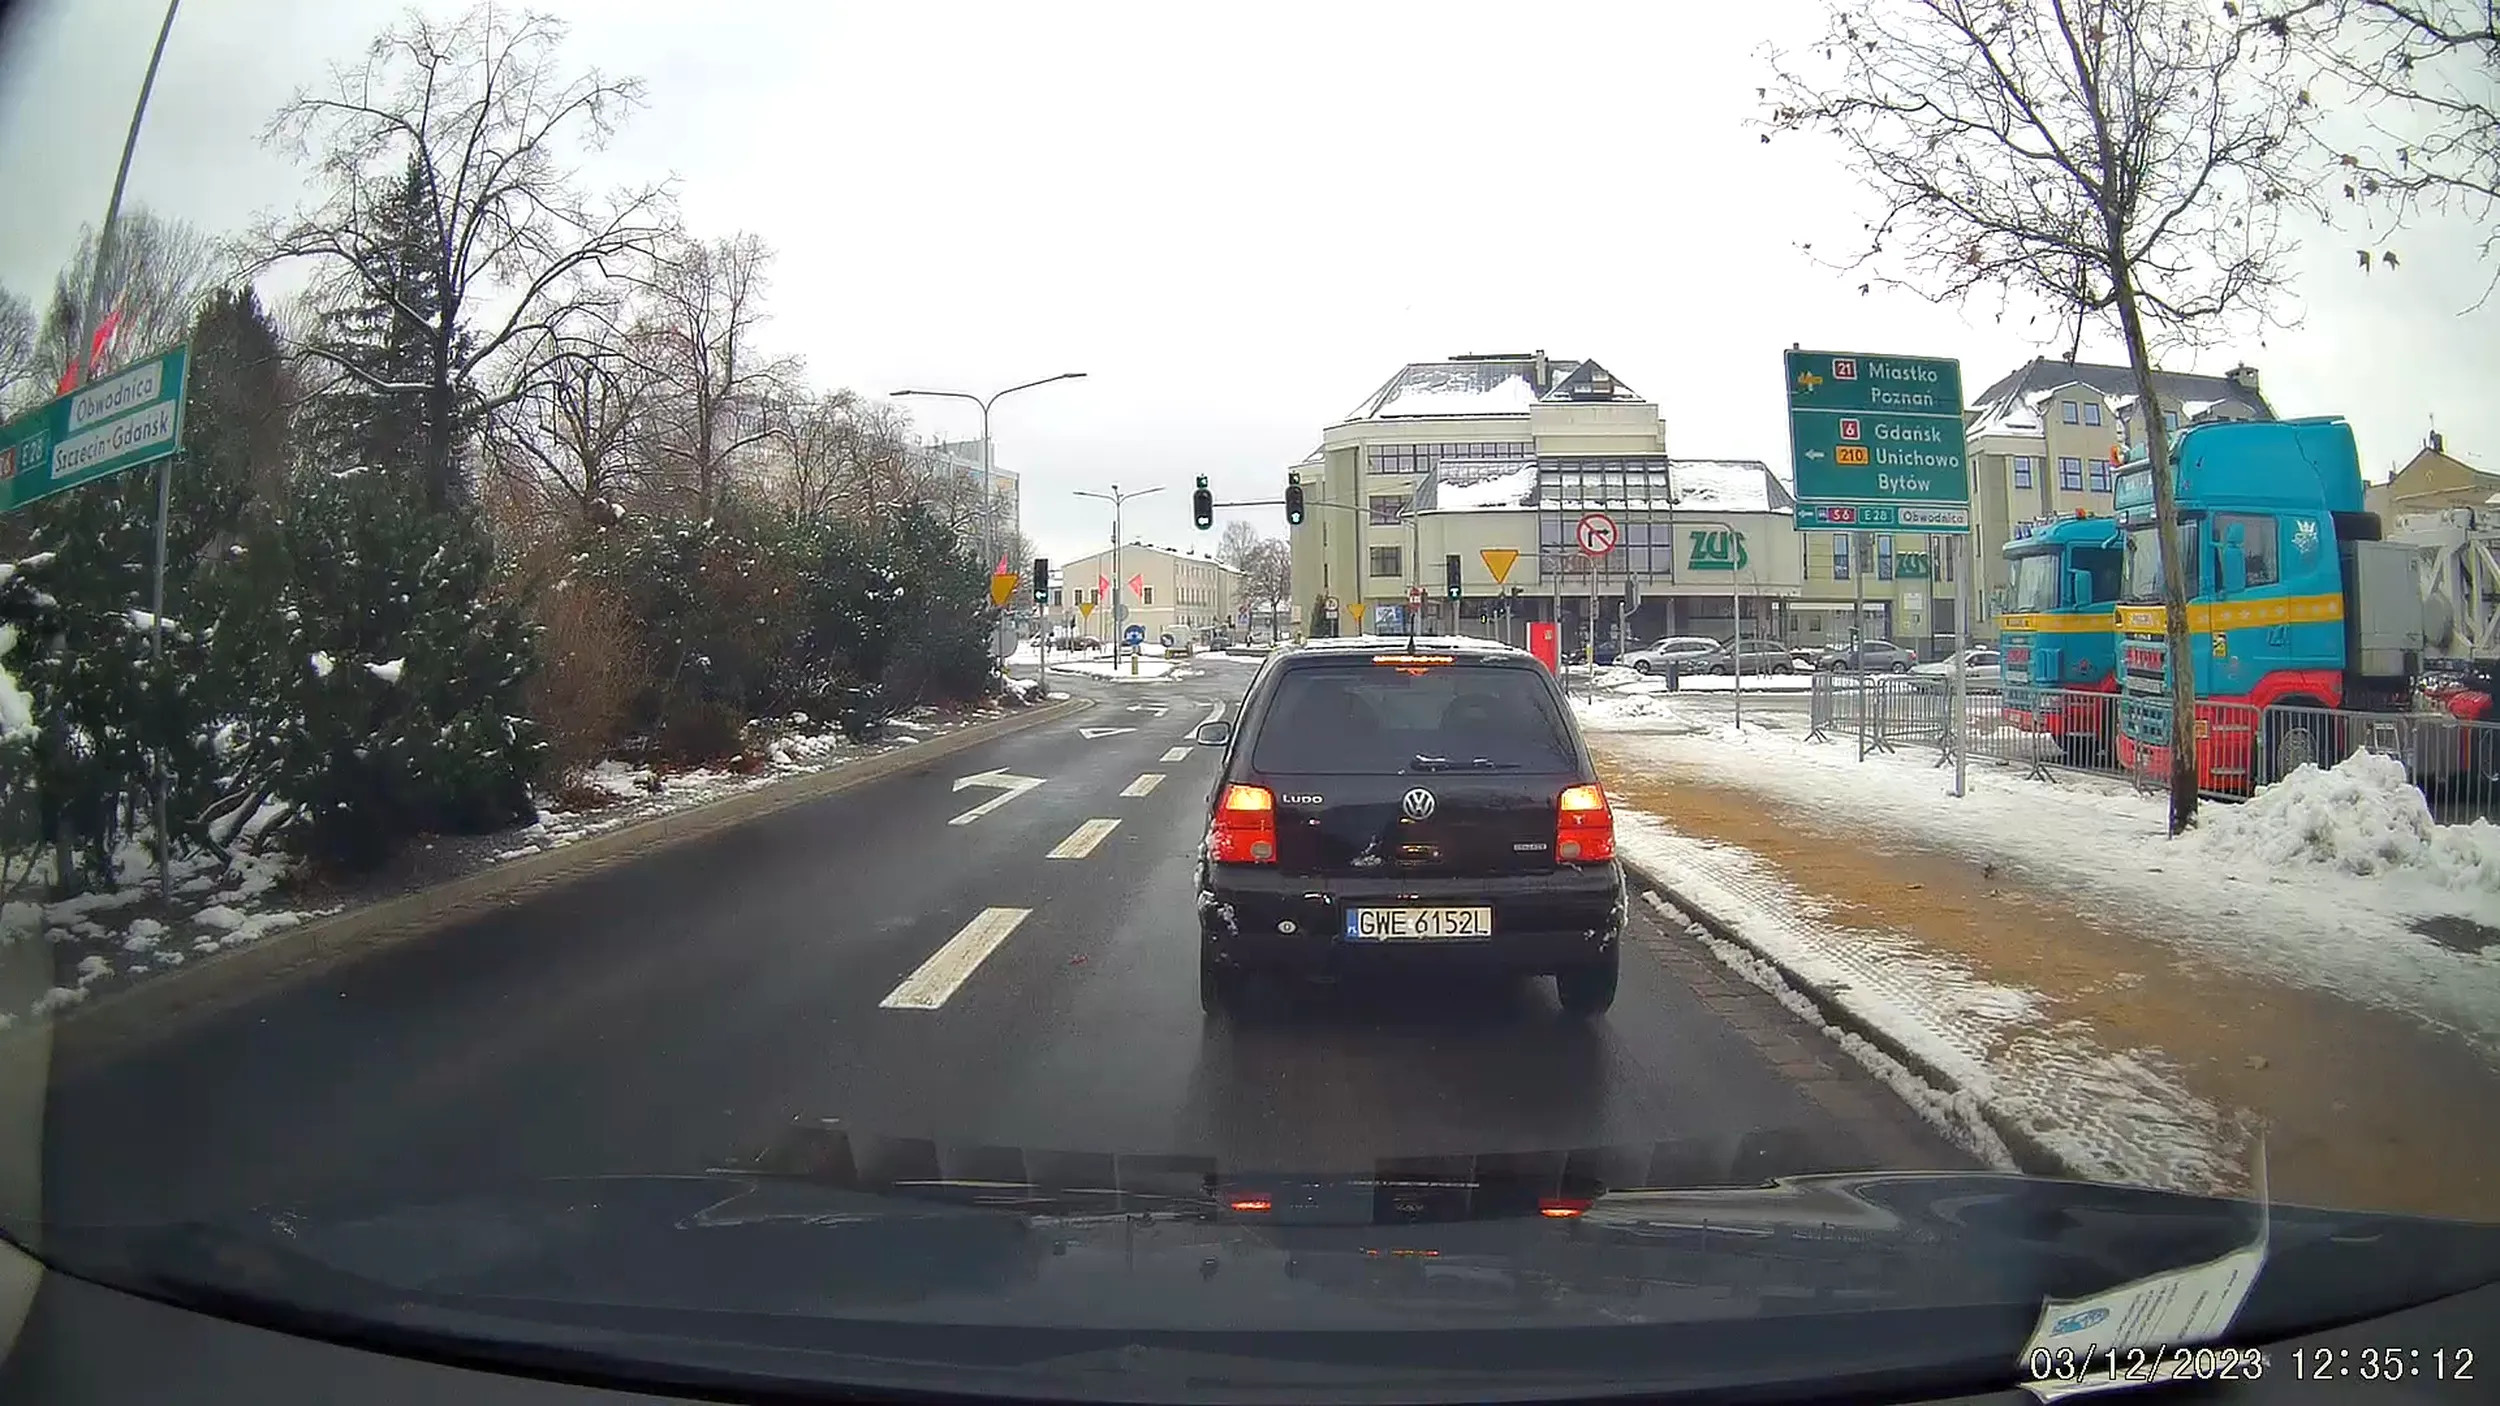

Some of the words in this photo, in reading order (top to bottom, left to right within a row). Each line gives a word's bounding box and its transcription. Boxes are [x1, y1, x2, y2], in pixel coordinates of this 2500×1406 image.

[1837, 362, 1852, 376] 21
[1869, 362, 1938, 383] Miastko
[77, 377, 153, 421] Obwodnica
[1871, 387, 1934, 407] Poznań
[1845, 424, 1856, 437] 6
[1874, 423, 1942, 443] Gdańsk
[1840, 448, 1865, 462] 210
[1876, 447, 1960, 469] Unichowo
[1878, 473, 1932, 495] Bytów
[1902, 511, 1965, 524] Obwodnica
[1687, 531, 1748, 570] ZUS
[1360, 910, 1407, 935] GWE
[1415, 910, 1489, 935] 6152L
